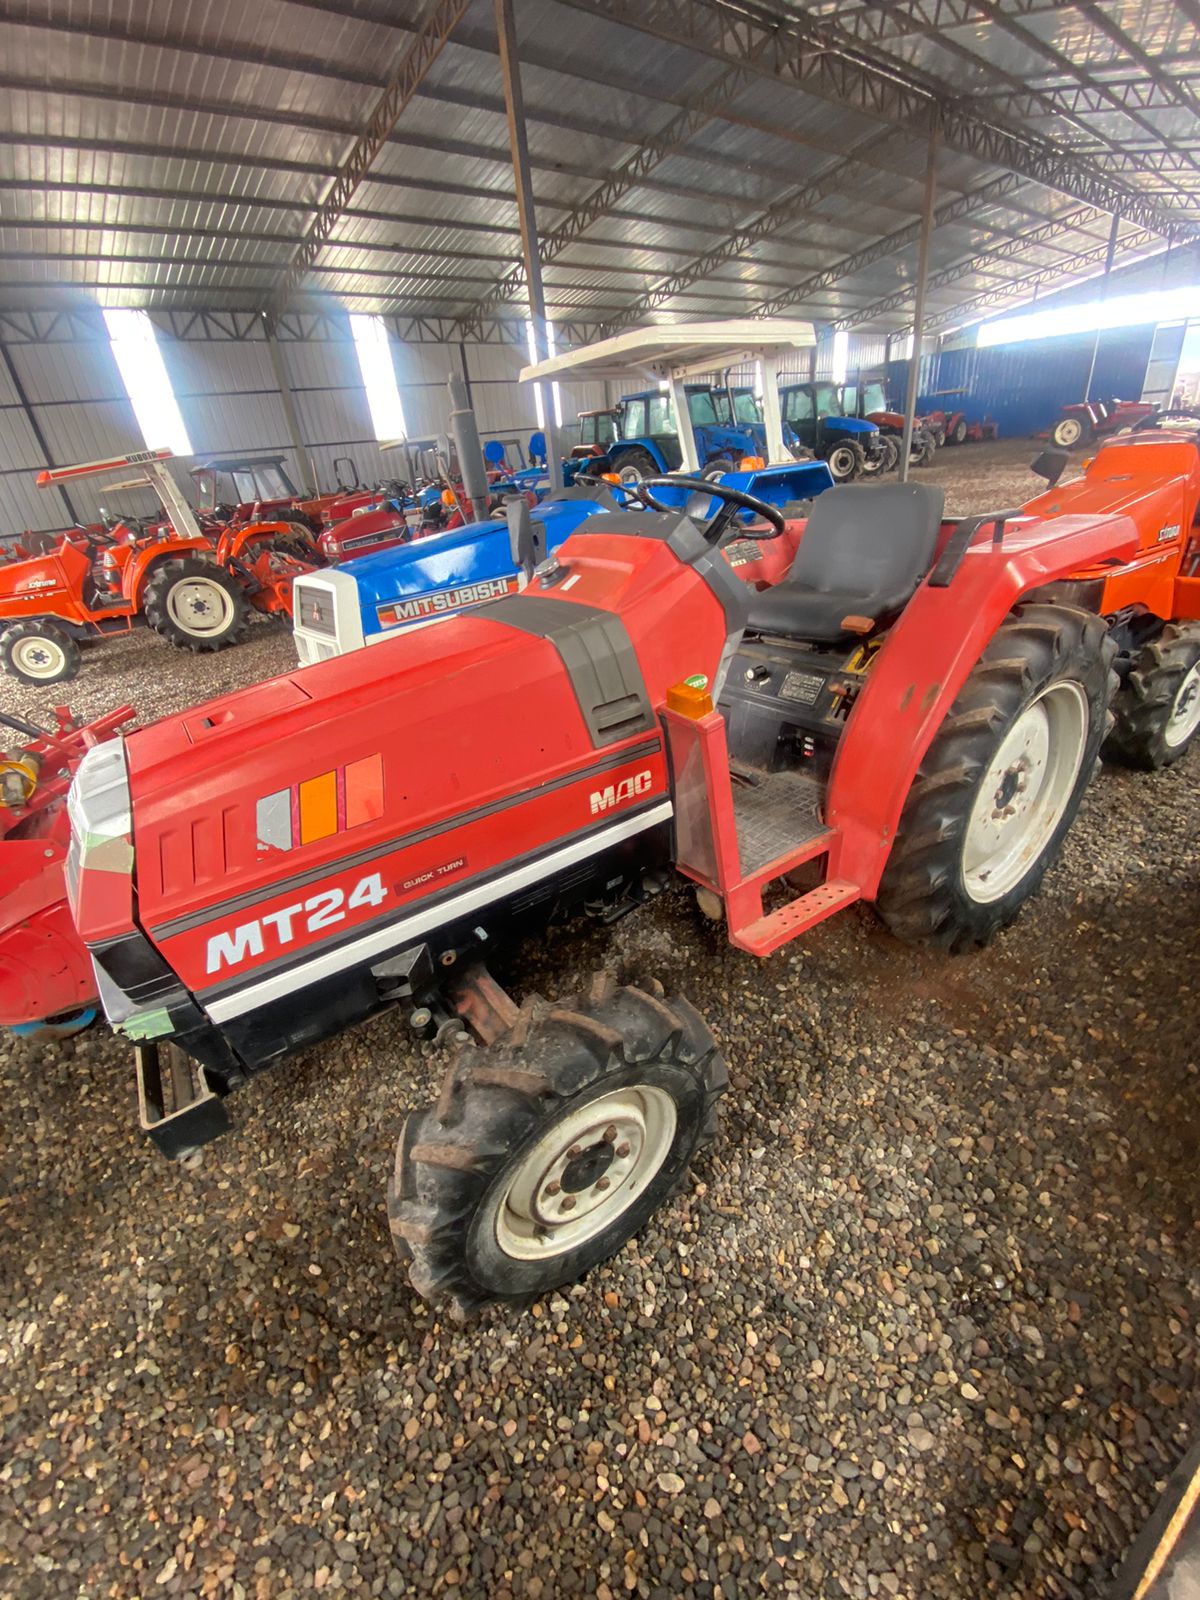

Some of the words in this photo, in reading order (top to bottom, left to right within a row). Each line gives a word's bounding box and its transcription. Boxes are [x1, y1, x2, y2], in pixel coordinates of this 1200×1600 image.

[125, 451, 157, 463] KUBOTA
[393, 579, 509, 620] MITSUBISHI
[590, 770, 652, 815] MAC
[403, 872, 434, 889] QUICK
[437, 859, 463, 874] TURN
[206, 872, 388, 974] MT24
